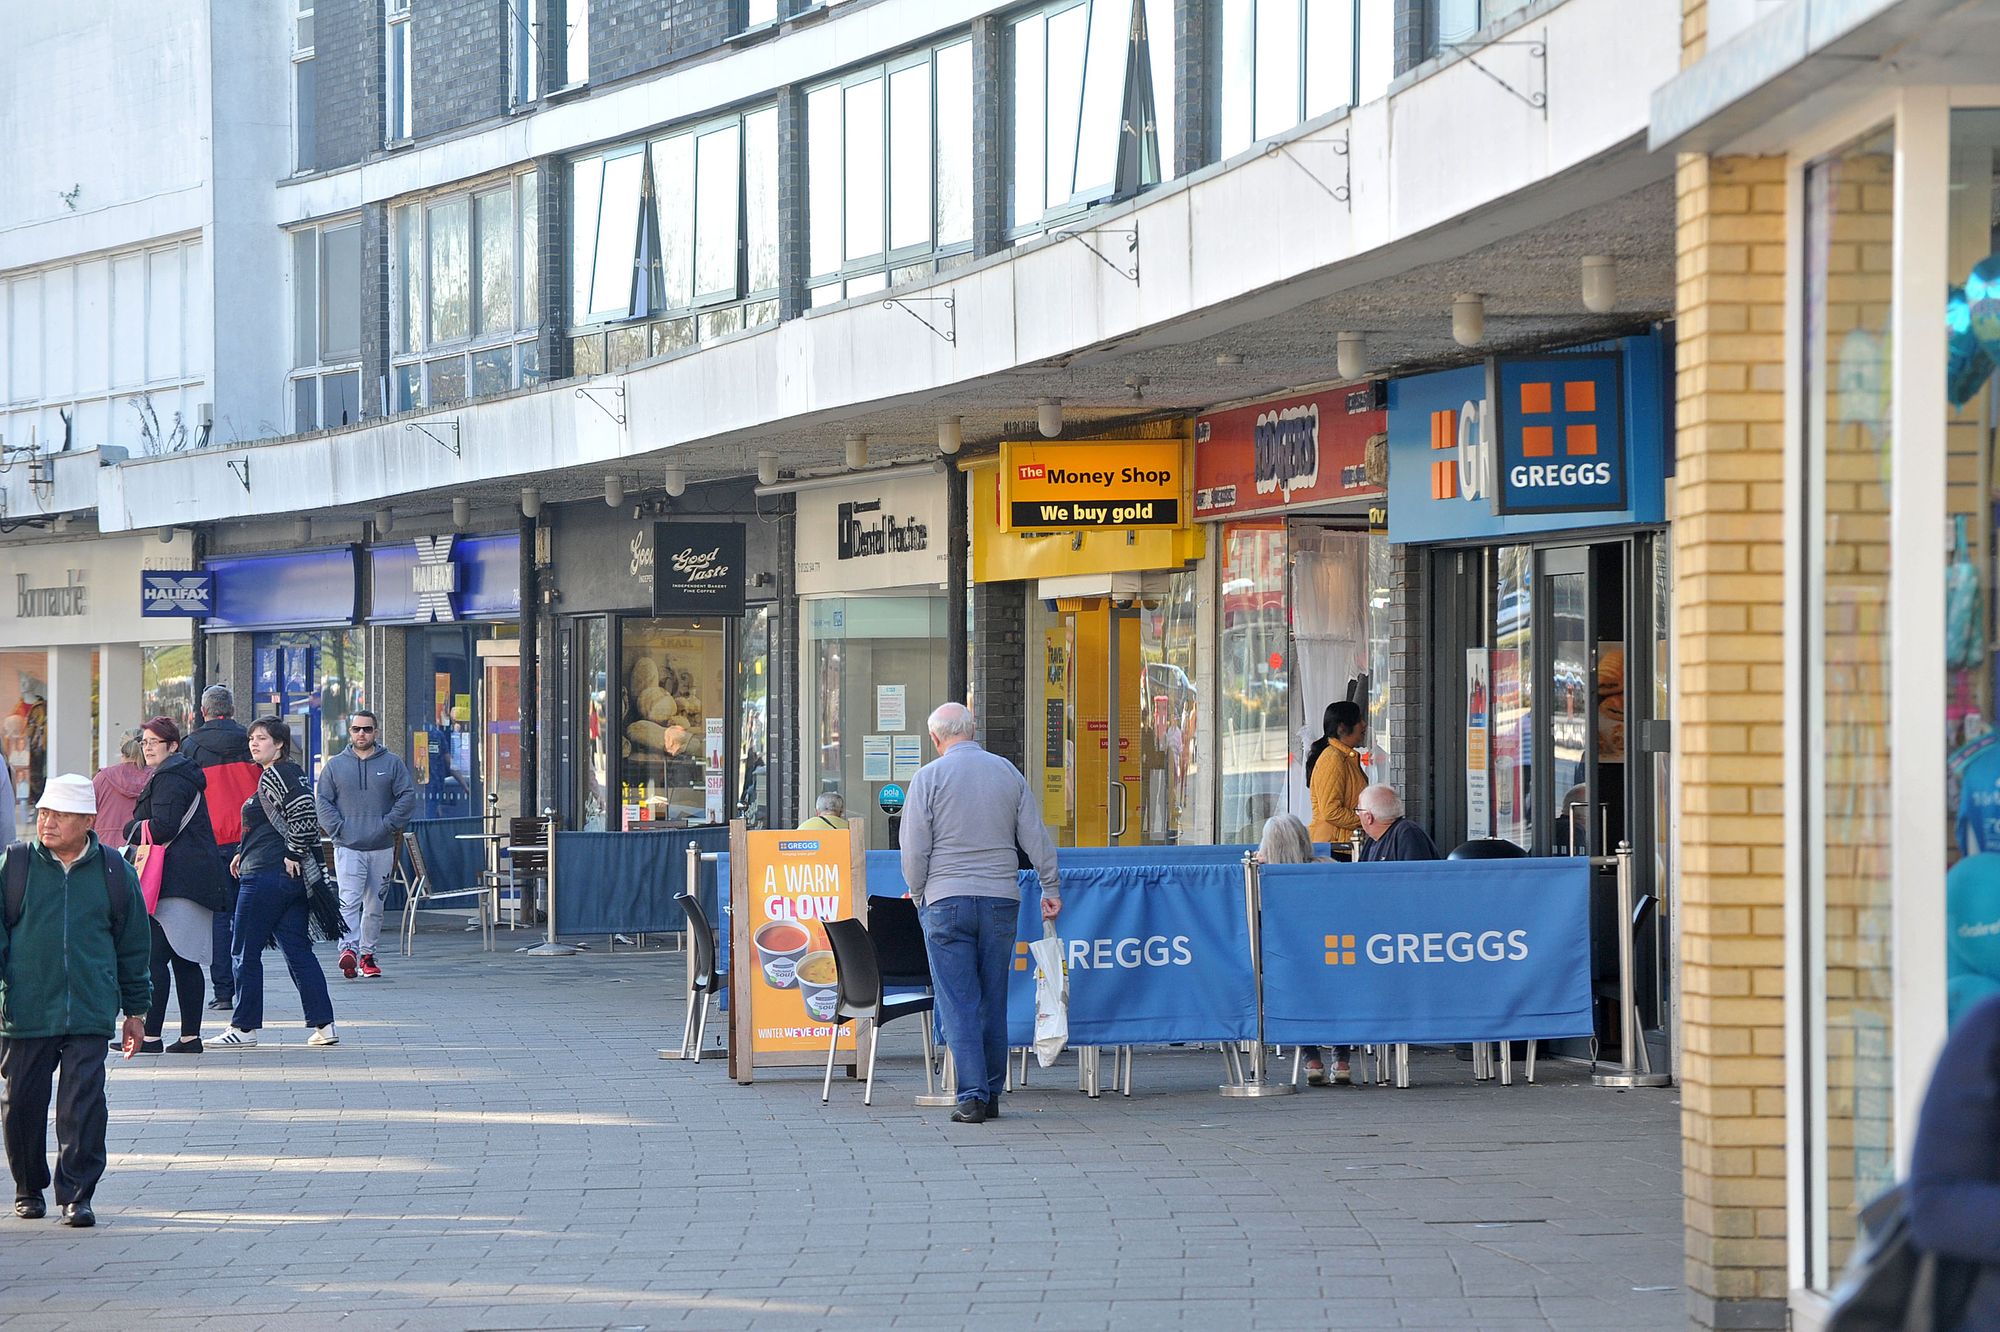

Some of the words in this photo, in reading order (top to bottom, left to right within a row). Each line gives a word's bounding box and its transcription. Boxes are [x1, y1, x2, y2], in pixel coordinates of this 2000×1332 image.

[1020, 467, 1043, 479] The
[1047, 469, 1114, 487] Money
[1122, 467, 1171, 486] Shop
[1510, 462, 1611, 488] GREGGS
[1040, 505, 1068, 521] We
[1073, 503, 1107, 523] buy
[1112, 503, 1153, 523] gold
[671, 547, 720, 571] Good
[684, 561, 729, 582] Taste
[412, 563, 454, 593] HALIFAX
[144, 588, 209, 600] HALIFAX
[764, 863, 777, 894] A
[783, 863, 840, 893] WARM
[764, 894, 840, 922] GLOW
[1068, 935, 1193, 970] REGGS
[1365, 929, 1529, 965] GREGGS
[758, 1028, 784, 1039] WINTER
[784, 1027, 812, 1038] WE'VE
[813, 1026, 830, 1037] GOT
